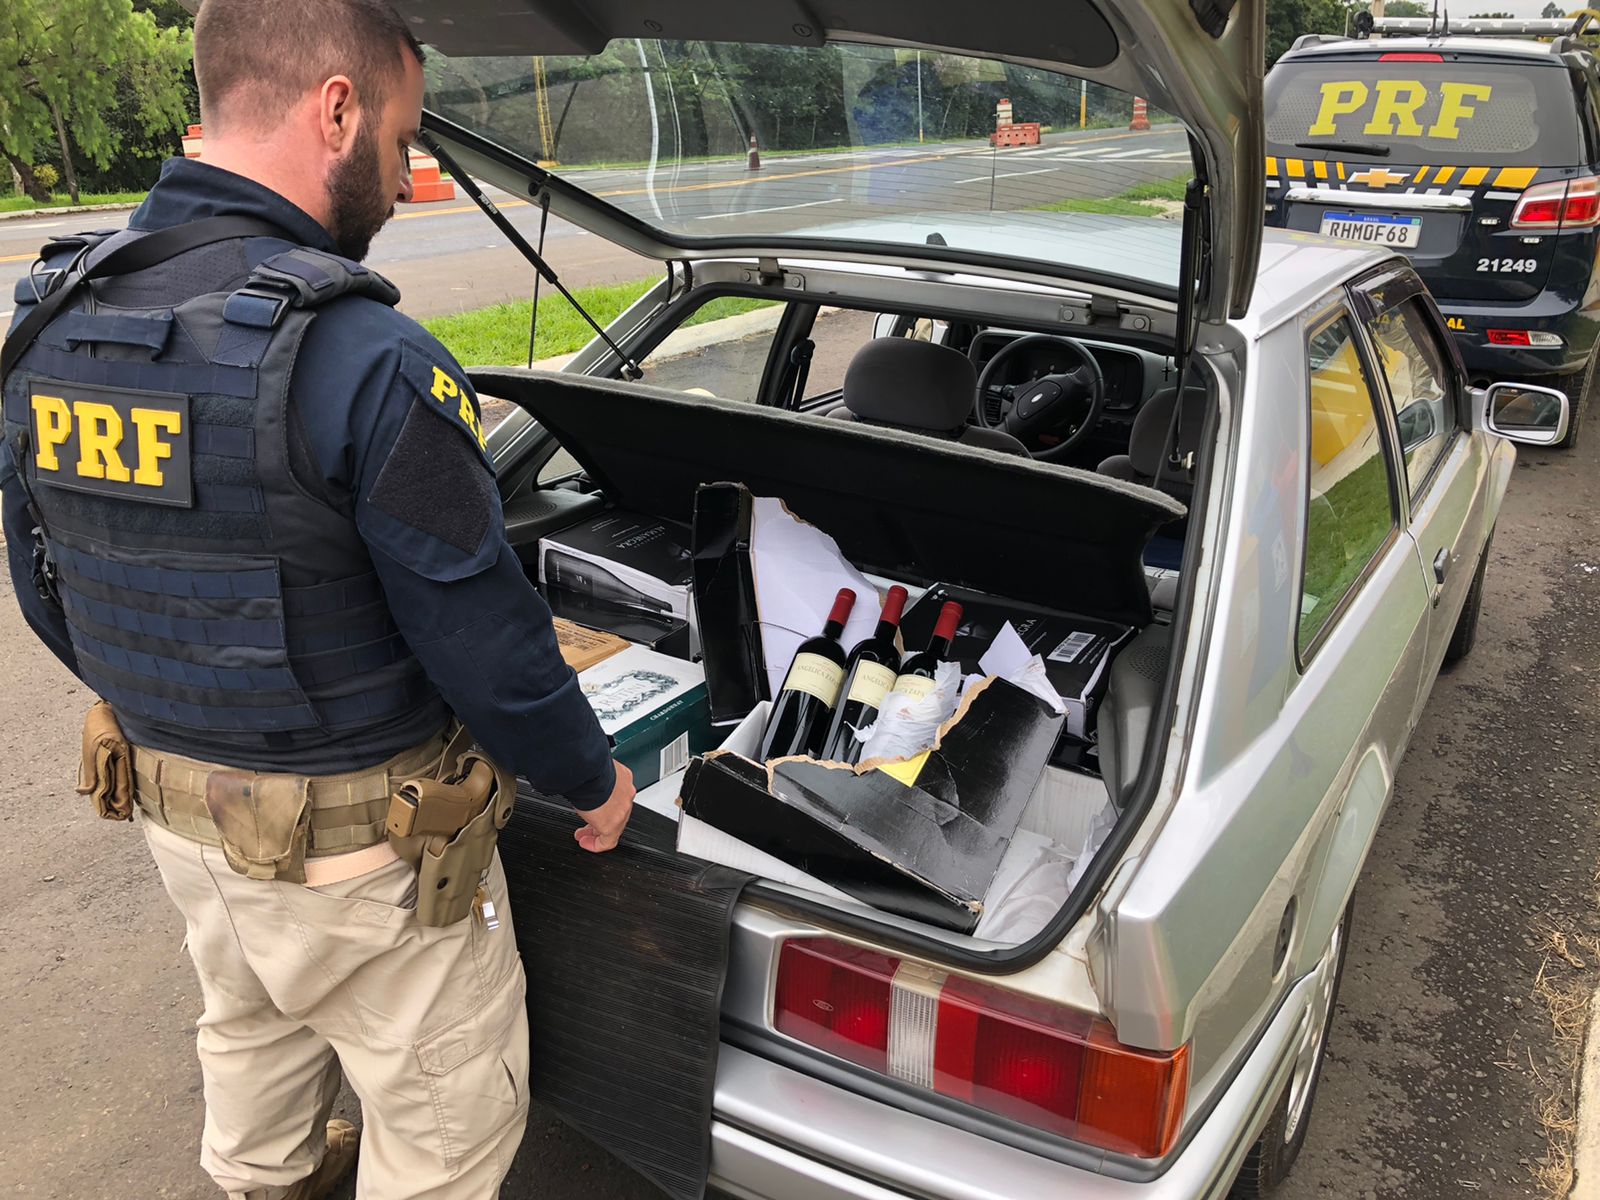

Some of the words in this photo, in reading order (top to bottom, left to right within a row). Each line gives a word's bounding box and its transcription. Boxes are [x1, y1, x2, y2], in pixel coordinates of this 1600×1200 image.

[1308, 80, 1492, 139] PRF
[1476, 258, 1538, 273] 21249
[31, 394, 181, 487] PRF
